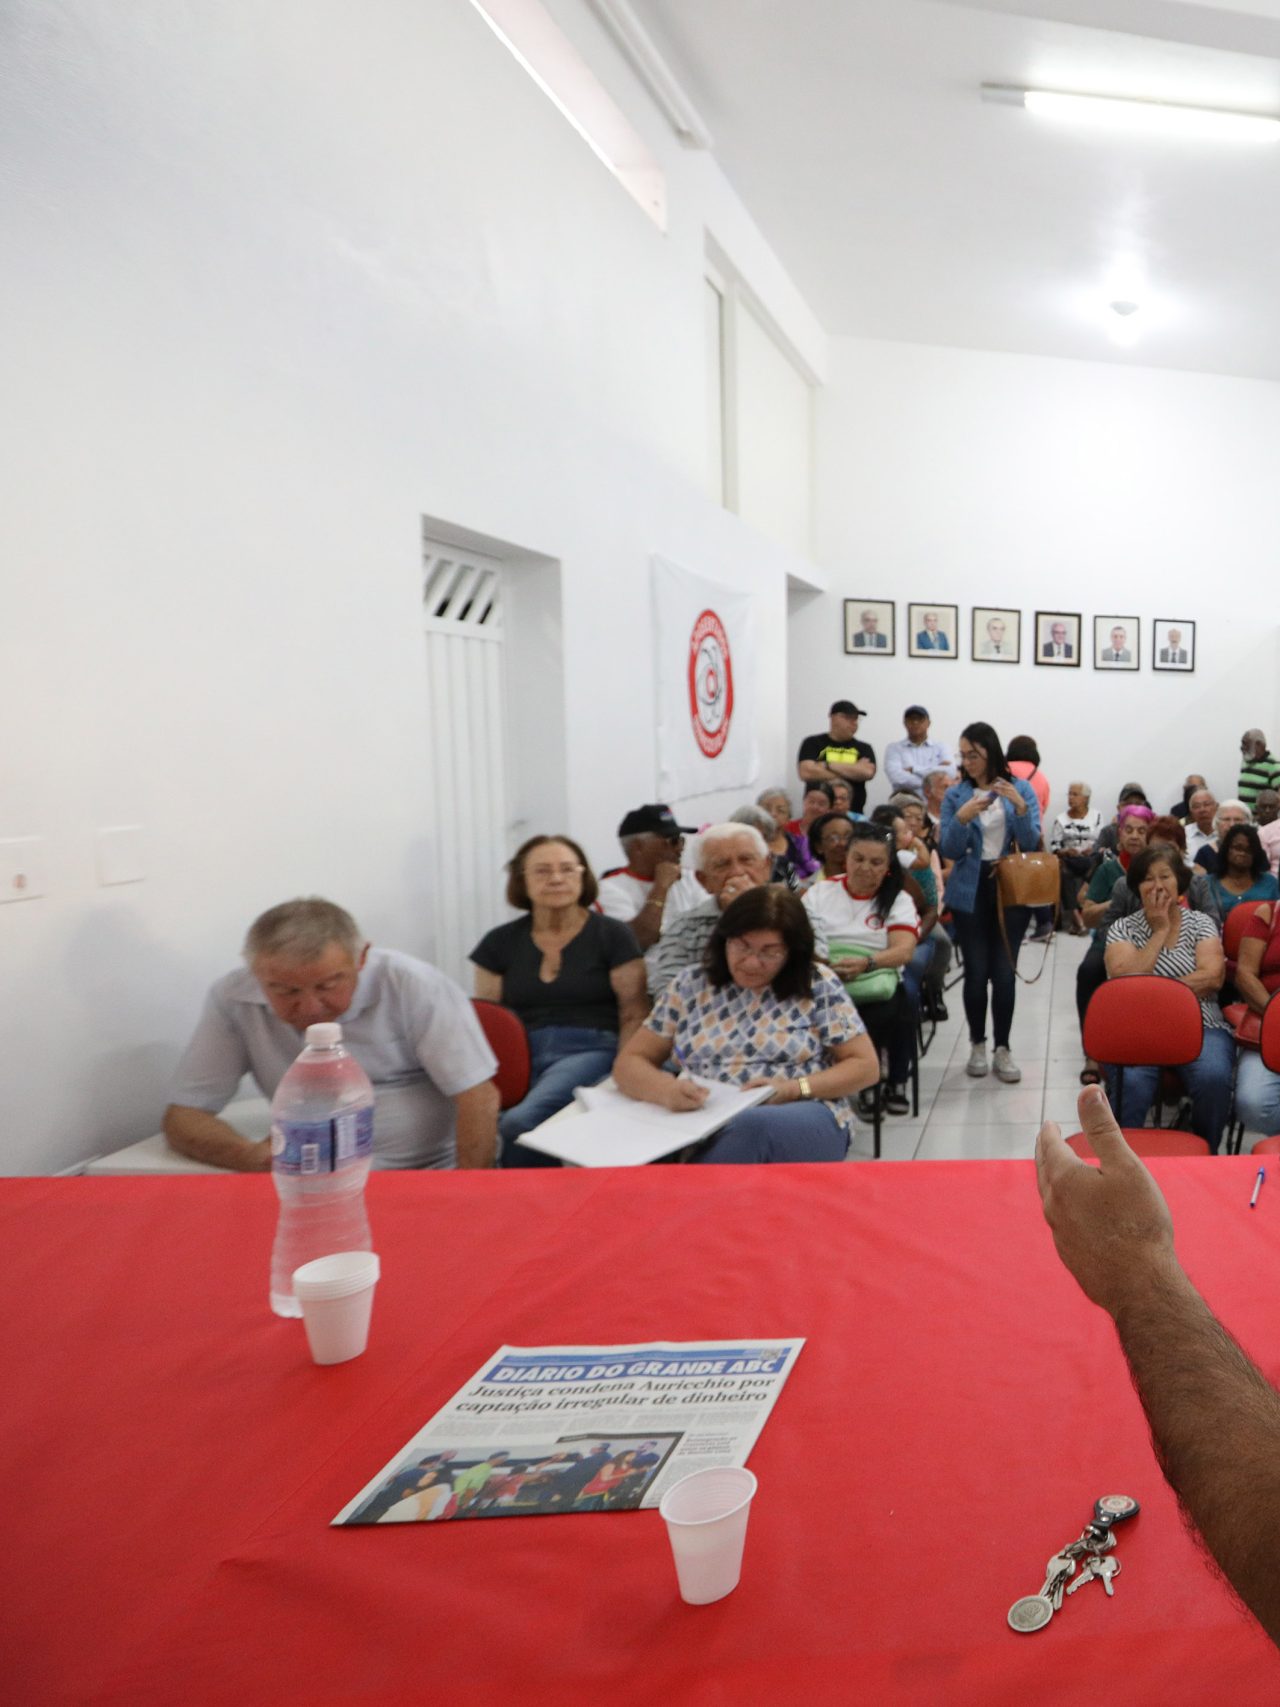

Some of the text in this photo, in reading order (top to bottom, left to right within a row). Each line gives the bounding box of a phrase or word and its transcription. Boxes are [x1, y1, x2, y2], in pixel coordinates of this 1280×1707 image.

[585, 1364, 625, 1379] DO
[626, 1361, 728, 1376] GRANDE
[727, 1359, 776, 1373] ABC
[468, 1378, 775, 1399] Justiça condena Auricchio por
[455, 1390, 767, 1414] captação irregular de dinheiro
